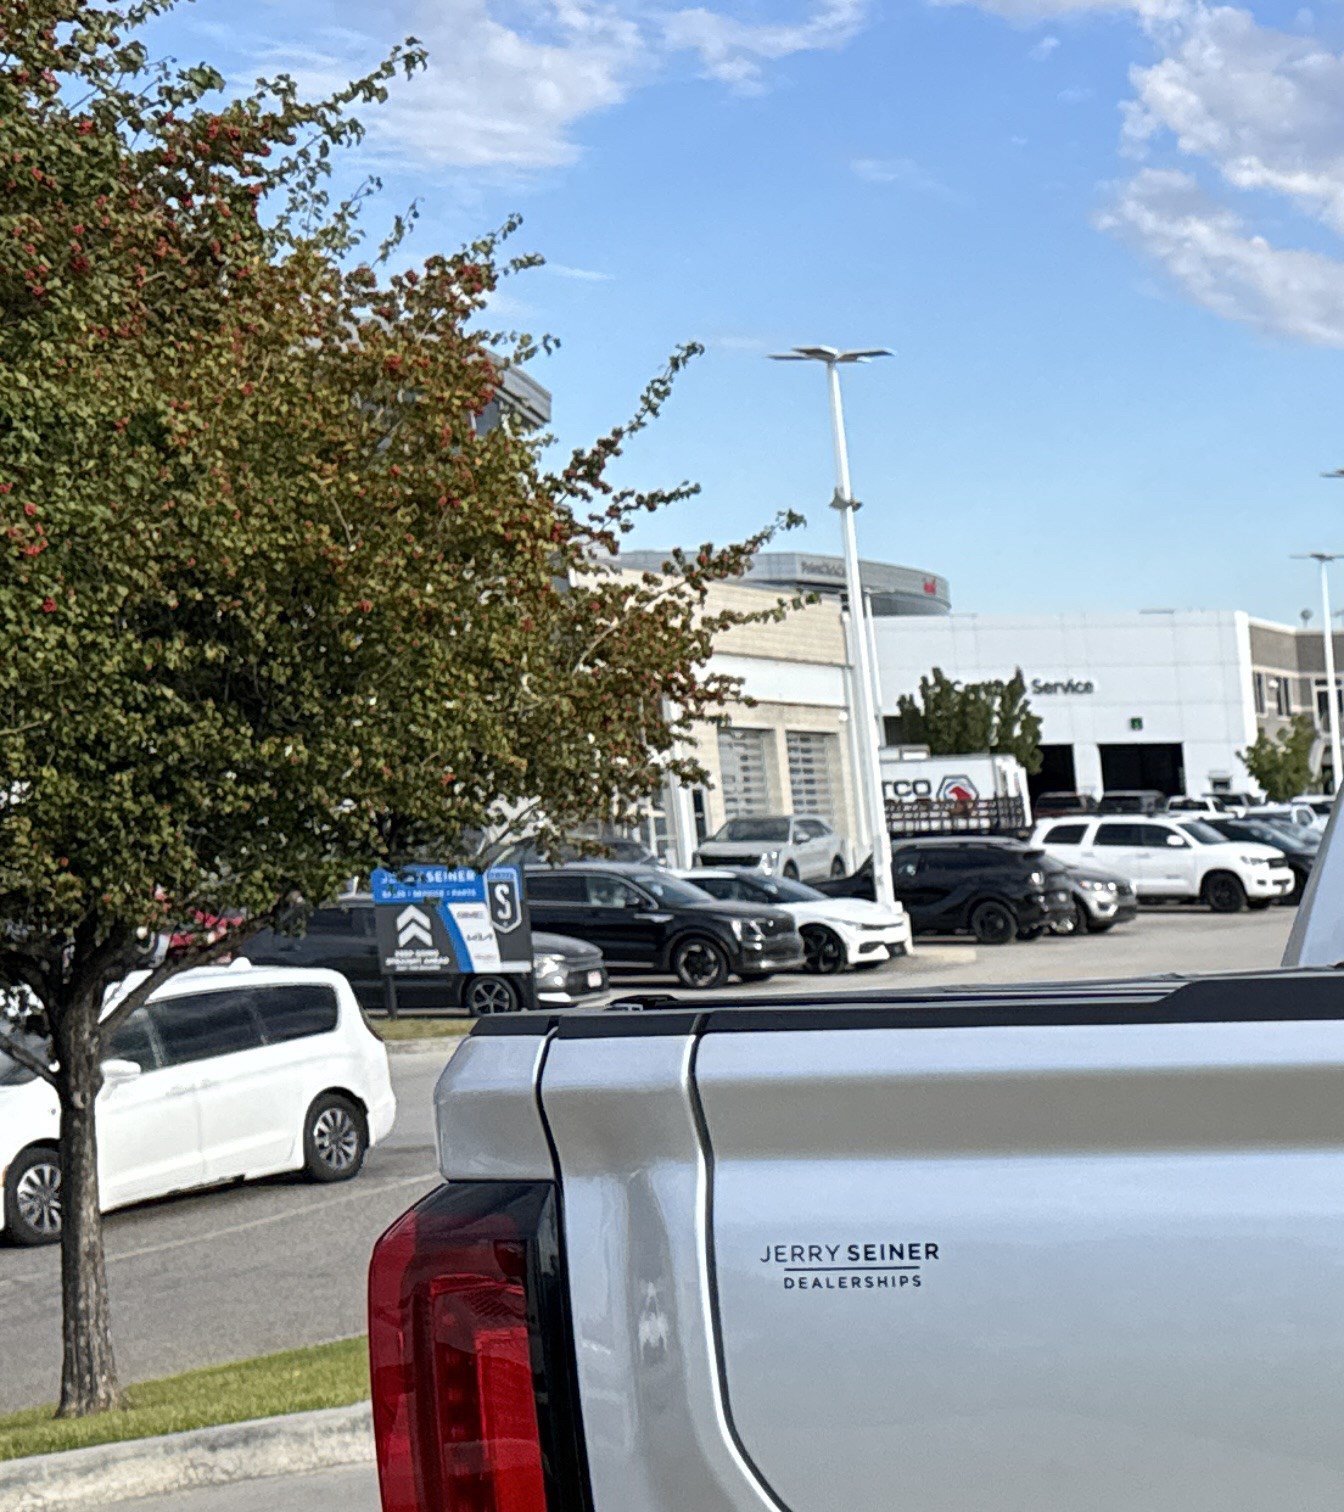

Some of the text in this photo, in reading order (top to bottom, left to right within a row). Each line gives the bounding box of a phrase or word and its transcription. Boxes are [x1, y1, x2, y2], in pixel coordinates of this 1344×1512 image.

[1032, 679, 1094, 694] Service
[426, 871, 476, 883] SEINER
[760, 1243, 940, 1263] JERRY SEINER
[784, 1275, 922, 1289] DEALERSHIPS
